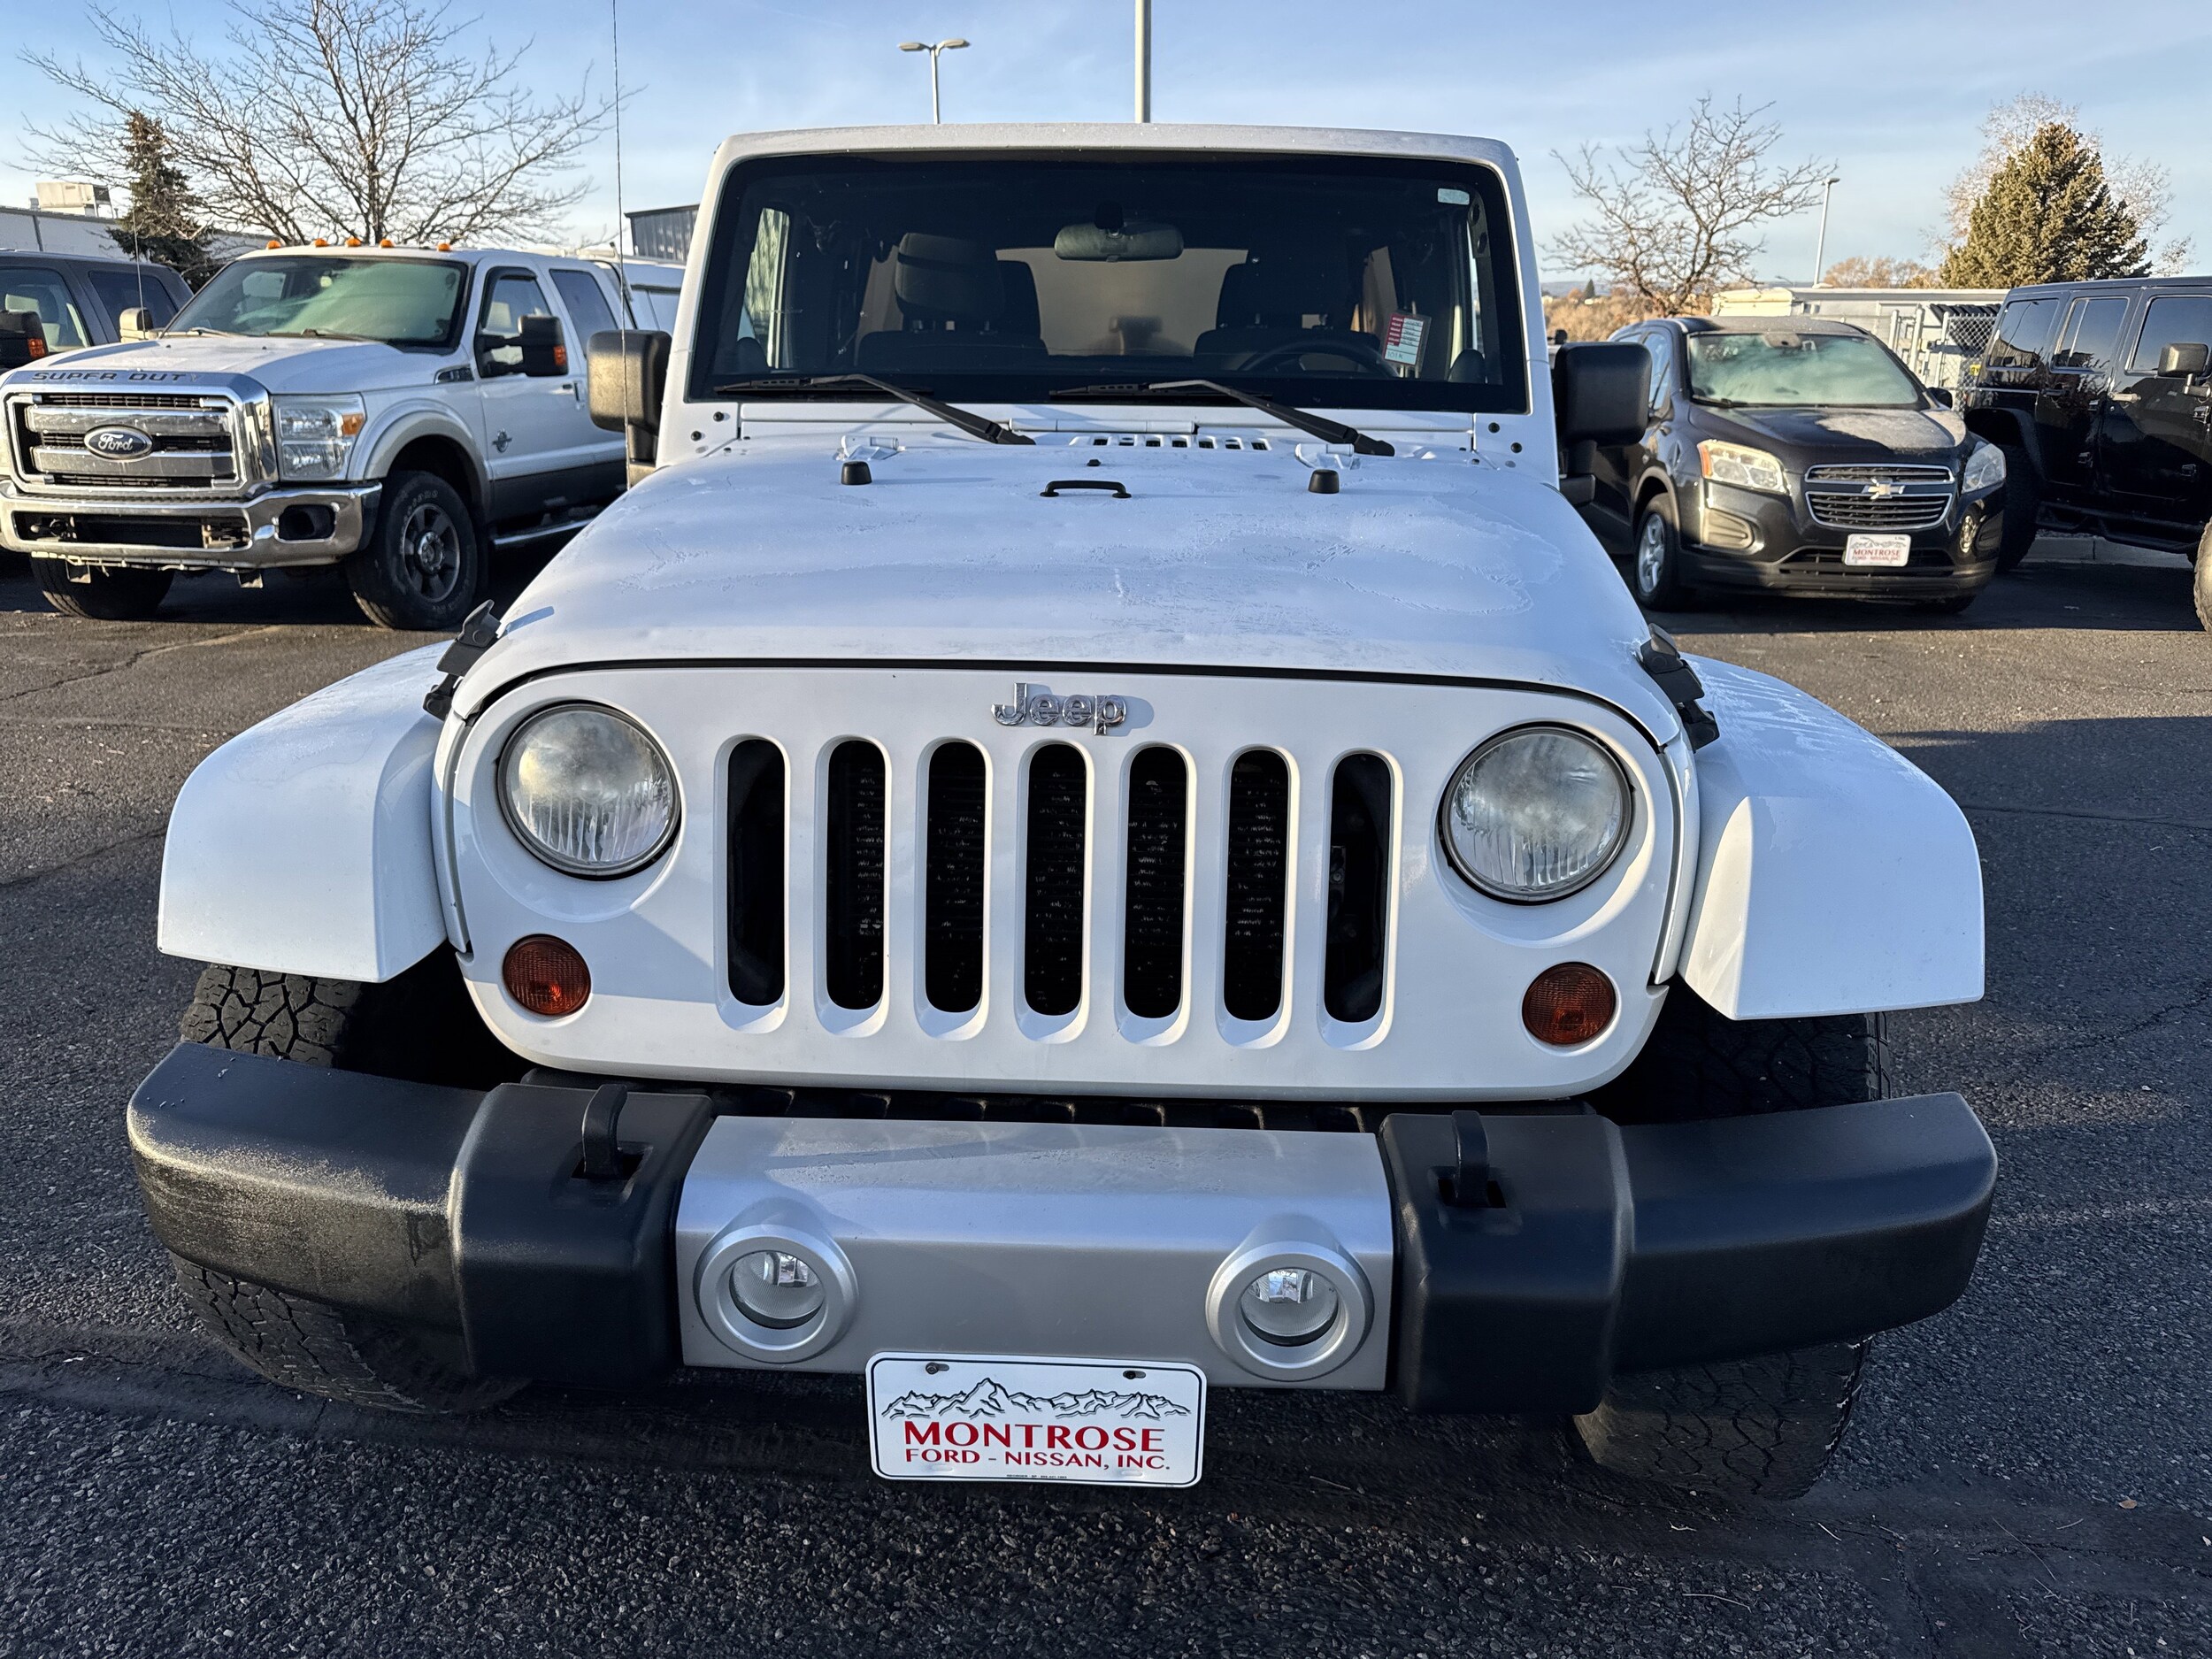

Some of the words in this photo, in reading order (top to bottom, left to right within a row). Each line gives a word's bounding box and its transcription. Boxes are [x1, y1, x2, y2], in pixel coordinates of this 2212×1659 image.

[97, 433, 134, 450] Ford
[991, 682, 1127, 736] Jeep
[904, 1420, 1165, 1452] MONTROSE
[905, 1448, 980, 1463] FORD
[1005, 1451, 1110, 1471] NISSAN,
[1118, 1454, 1171, 1470] INC.
